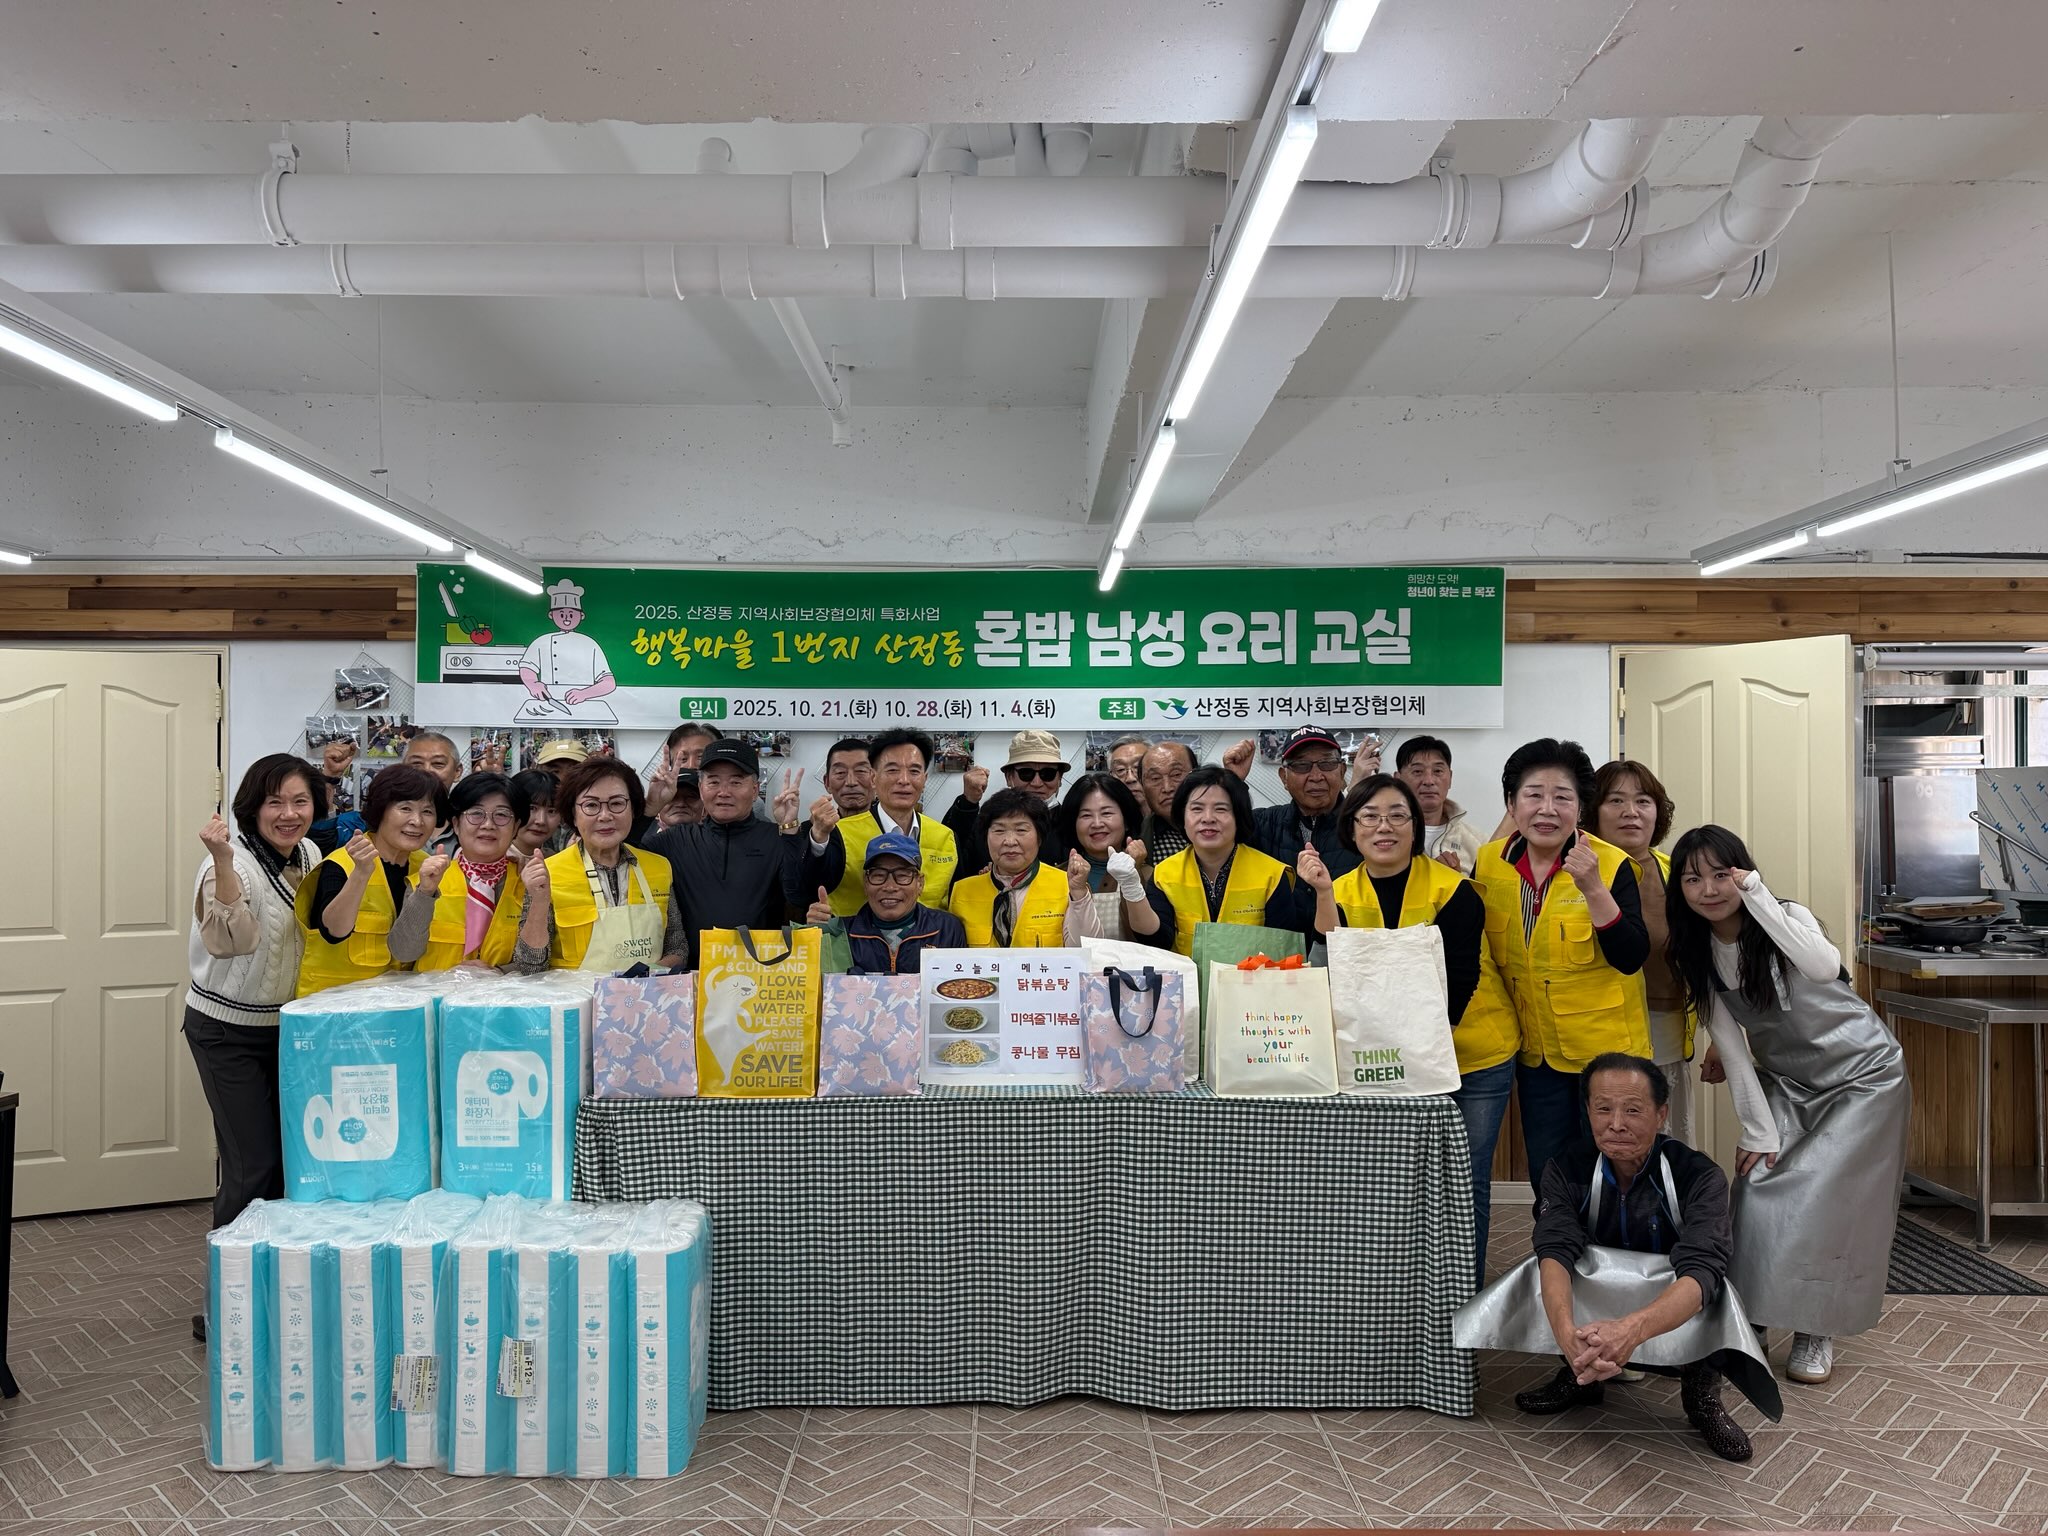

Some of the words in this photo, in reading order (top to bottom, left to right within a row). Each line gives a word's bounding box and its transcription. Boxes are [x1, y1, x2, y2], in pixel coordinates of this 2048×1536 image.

[1407, 574, 1435, 584] 희망찬
[1437, 573, 1459, 584] 도약!
[1407, 586, 1436, 597] 청년이
[1439, 586, 1459, 597] 찾는
[1462, 586, 1472, 597] 큰
[1474, 586, 1495, 598] 목포
[634, 605, 681, 620] 2025.
[687, 606, 733, 621] 산정동
[738, 607, 875, 622] 지역사회보장협의체
[880, 607, 940, 621] 특화사업
[973, 610, 1075, 667] 혼밥
[1086, 610, 1185, 668] 남성
[1197, 609, 1297, 665] 요리
[1310, 607, 1412, 665] 교실
[630, 627, 755, 670] 행복마을
[771, 631, 860, 664] 1번지
[874, 630, 965, 668] 산정동
[688, 700, 718, 718] 일시
[733, 700, 782, 718] 2025.
[789, 700, 816, 718] 10.
[821, 699, 878, 720] 21.(화)
[885, 700, 911, 718] 10.
[916, 699, 972, 720] 28.(화)
[979, 700, 1005, 718] 11.
[1010, 698, 1056, 720] 4.(화)
[1107, 700, 1138, 719] 주최
[1194, 697, 1251, 719] 산정동
[1257, 696, 1425, 719] 지역사회보장협의체
[1291, 726, 1327, 741] PING
[623, 937, 652, 948] sweet
[629, 947, 653, 959] salty
[711, 944, 737, 960] I'M
[776, 962, 808, 973] AND
[767, 975, 807, 987] LOVE
[1017, 978, 1070, 991] 닭볶음탕
[758, 989, 806, 1001] CLEAN
[753, 1002, 808, 1014] WATER.
[755, 1016, 804, 1027] PLEASE
[1011, 1012, 1081, 1026] 미역줄기볶음
[1245, 1011, 1270, 1022] think
[1273, 1012, 1303, 1024] happy
[772, 1029, 804, 1039] SAVE
[1241, 1026, 1284, 1038] thoughts
[1288, 1025, 1311, 1035] with
[755, 1041, 804, 1052] WATER!
[1011, 1046, 1049, 1059] 콩나물
[1055, 1046, 1081, 1060] 무침
[1263, 1040, 1294, 1053] your
[1247, 1053, 1291, 1064] beautiful
[1294, 1053, 1310, 1062] life
[1351, 1047, 1402, 1065] THINK
[740, 1054, 803, 1073] SAVE
[1354, 1065, 1405, 1082] GREEN
[734, 1075, 765, 1088] OUR
[768, 1075, 803, 1088] LIFE!
[464, 1107, 493, 1119] 화장지
[524, 1360, 533, 1378] F12
